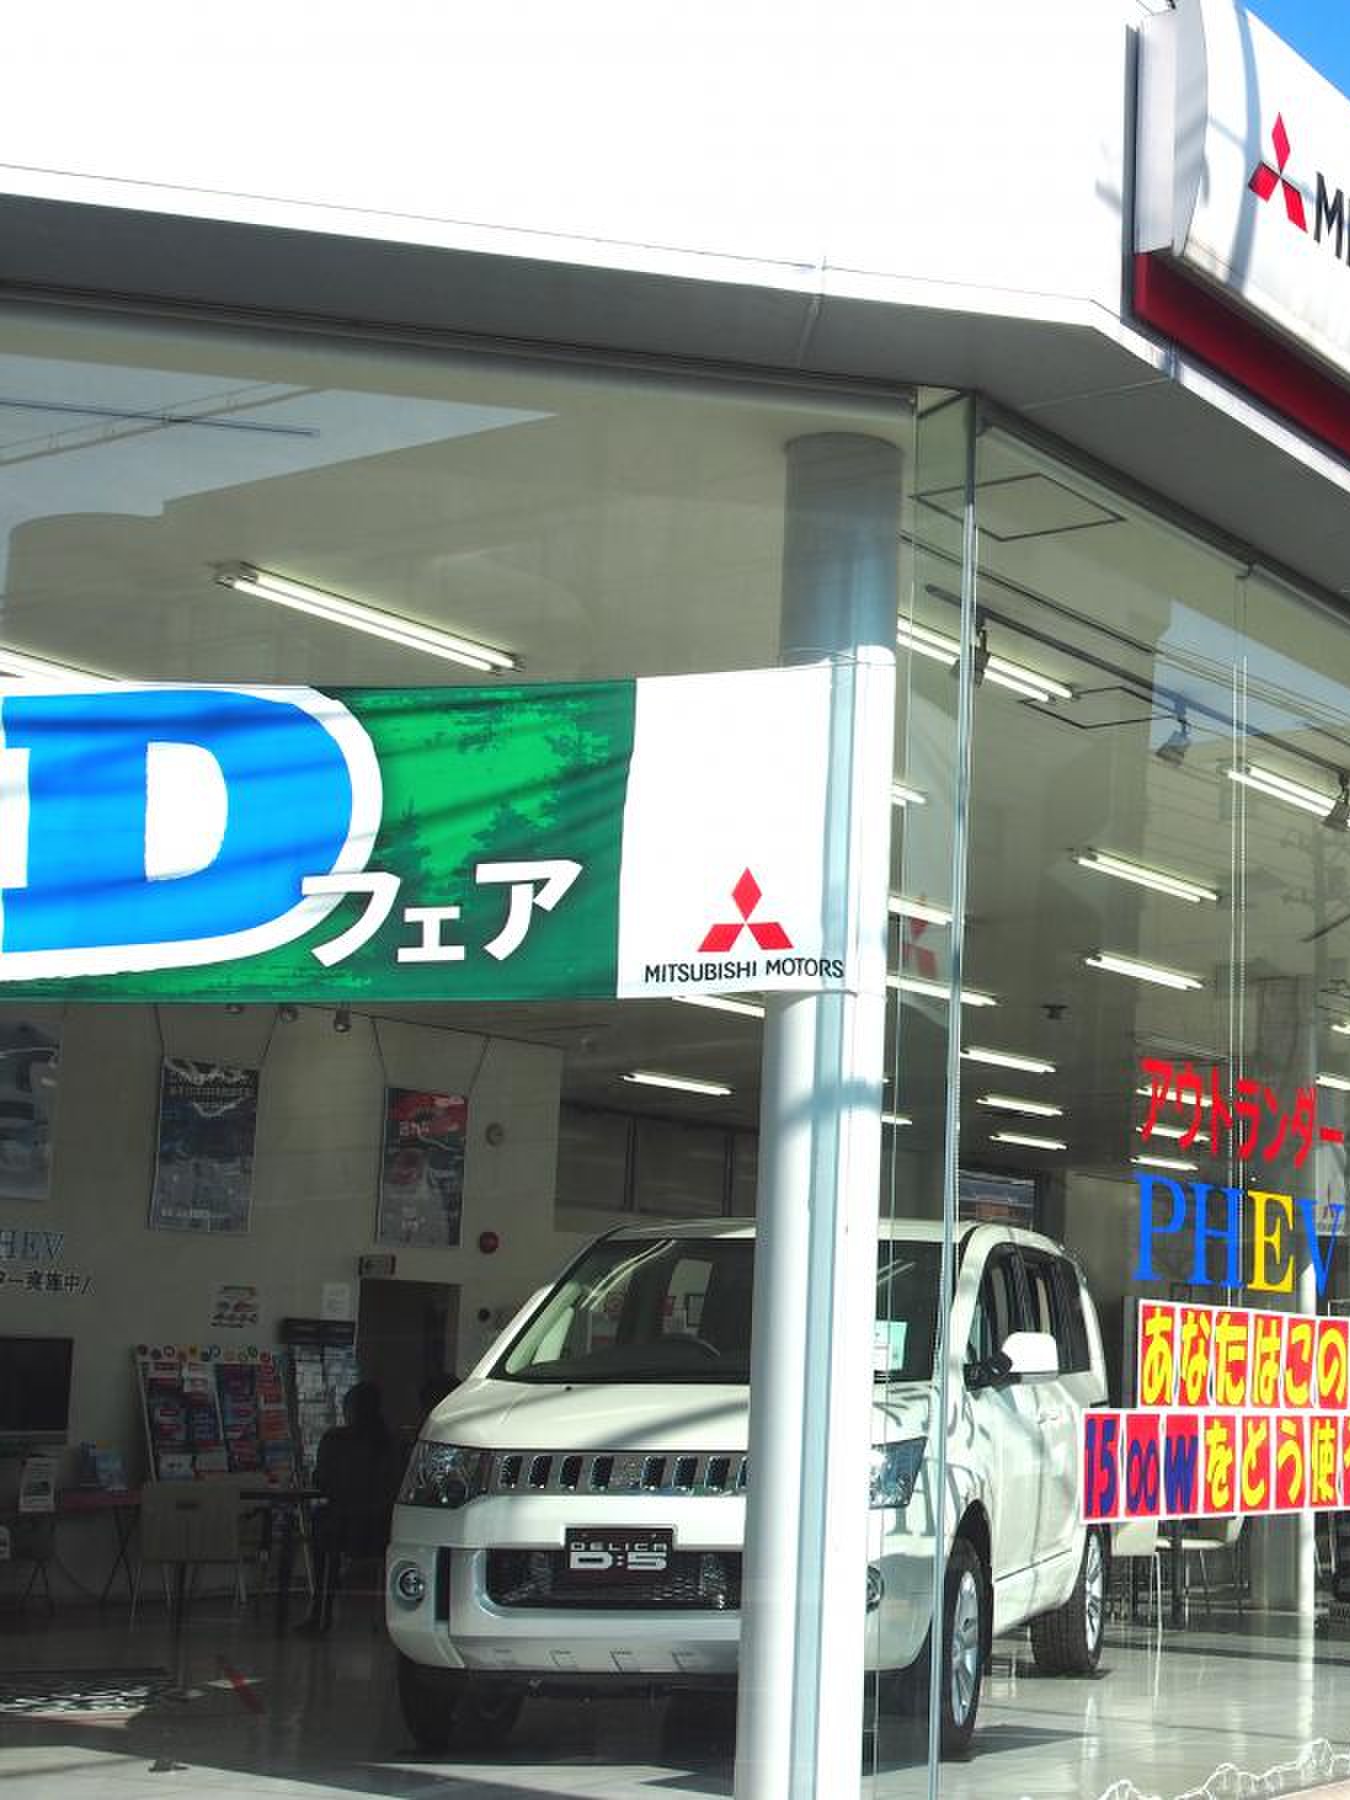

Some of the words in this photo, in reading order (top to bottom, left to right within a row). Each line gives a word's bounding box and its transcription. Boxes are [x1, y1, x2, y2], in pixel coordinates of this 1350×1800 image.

[301, 858, 583, 967] フェア
[645, 960, 757, 983] MITSUBISHI
[766, 957, 845, 979] MOTORS
[1140, 1057, 1345, 1169] アウトランダー
[1131, 1172, 1345, 1297] PHEV
[1143, 1305, 1347, 1405] あなたはこの
[570, 1552, 667, 1570] D:5
[571, 1542, 667, 1551] DELICA
